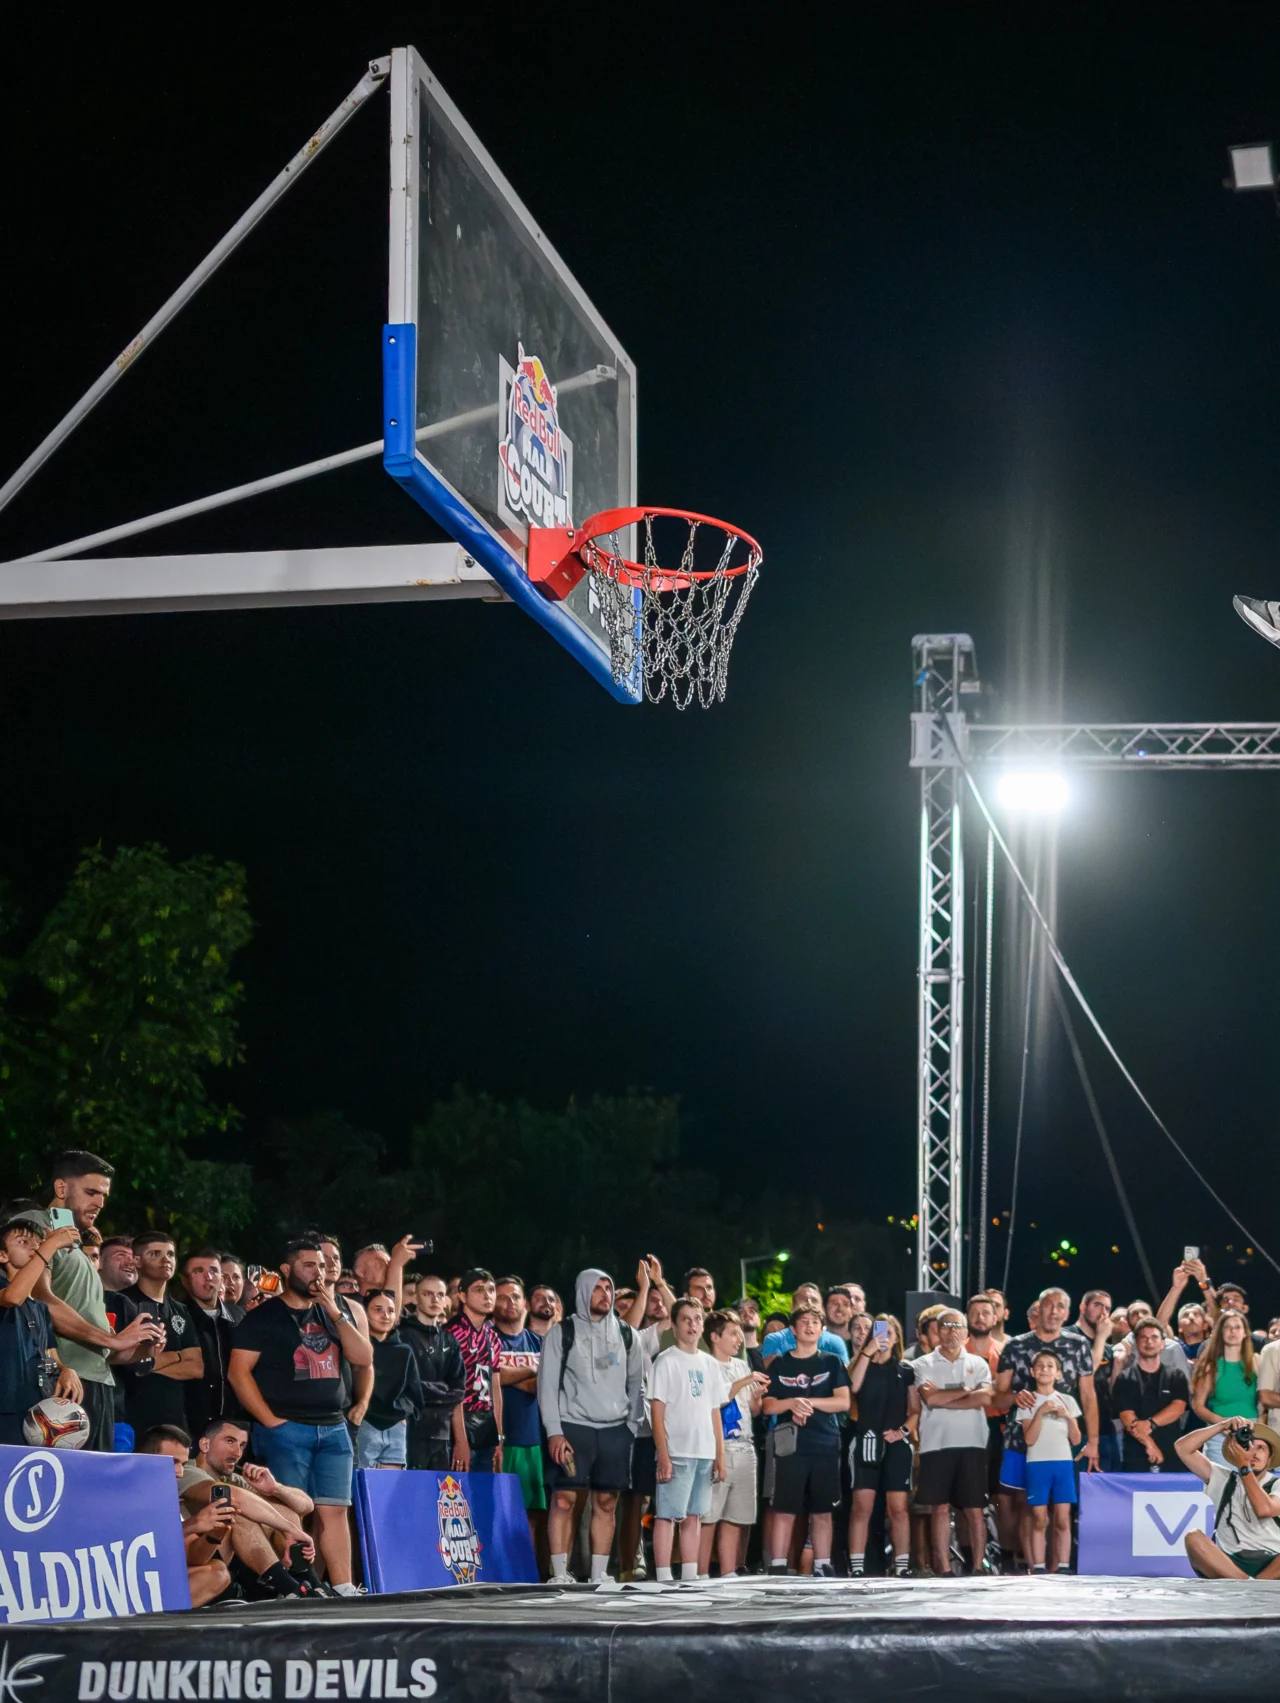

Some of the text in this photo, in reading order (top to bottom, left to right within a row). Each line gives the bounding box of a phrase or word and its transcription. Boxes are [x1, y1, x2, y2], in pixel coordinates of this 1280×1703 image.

[514, 381, 561, 463] Red Bull
[507, 443, 567, 529] COURT
[439, 1501, 469, 1518] Red Bull
[441, 1536, 481, 1567] COURT
[78, 1657, 438, 1701] DUNKING DEVILS
